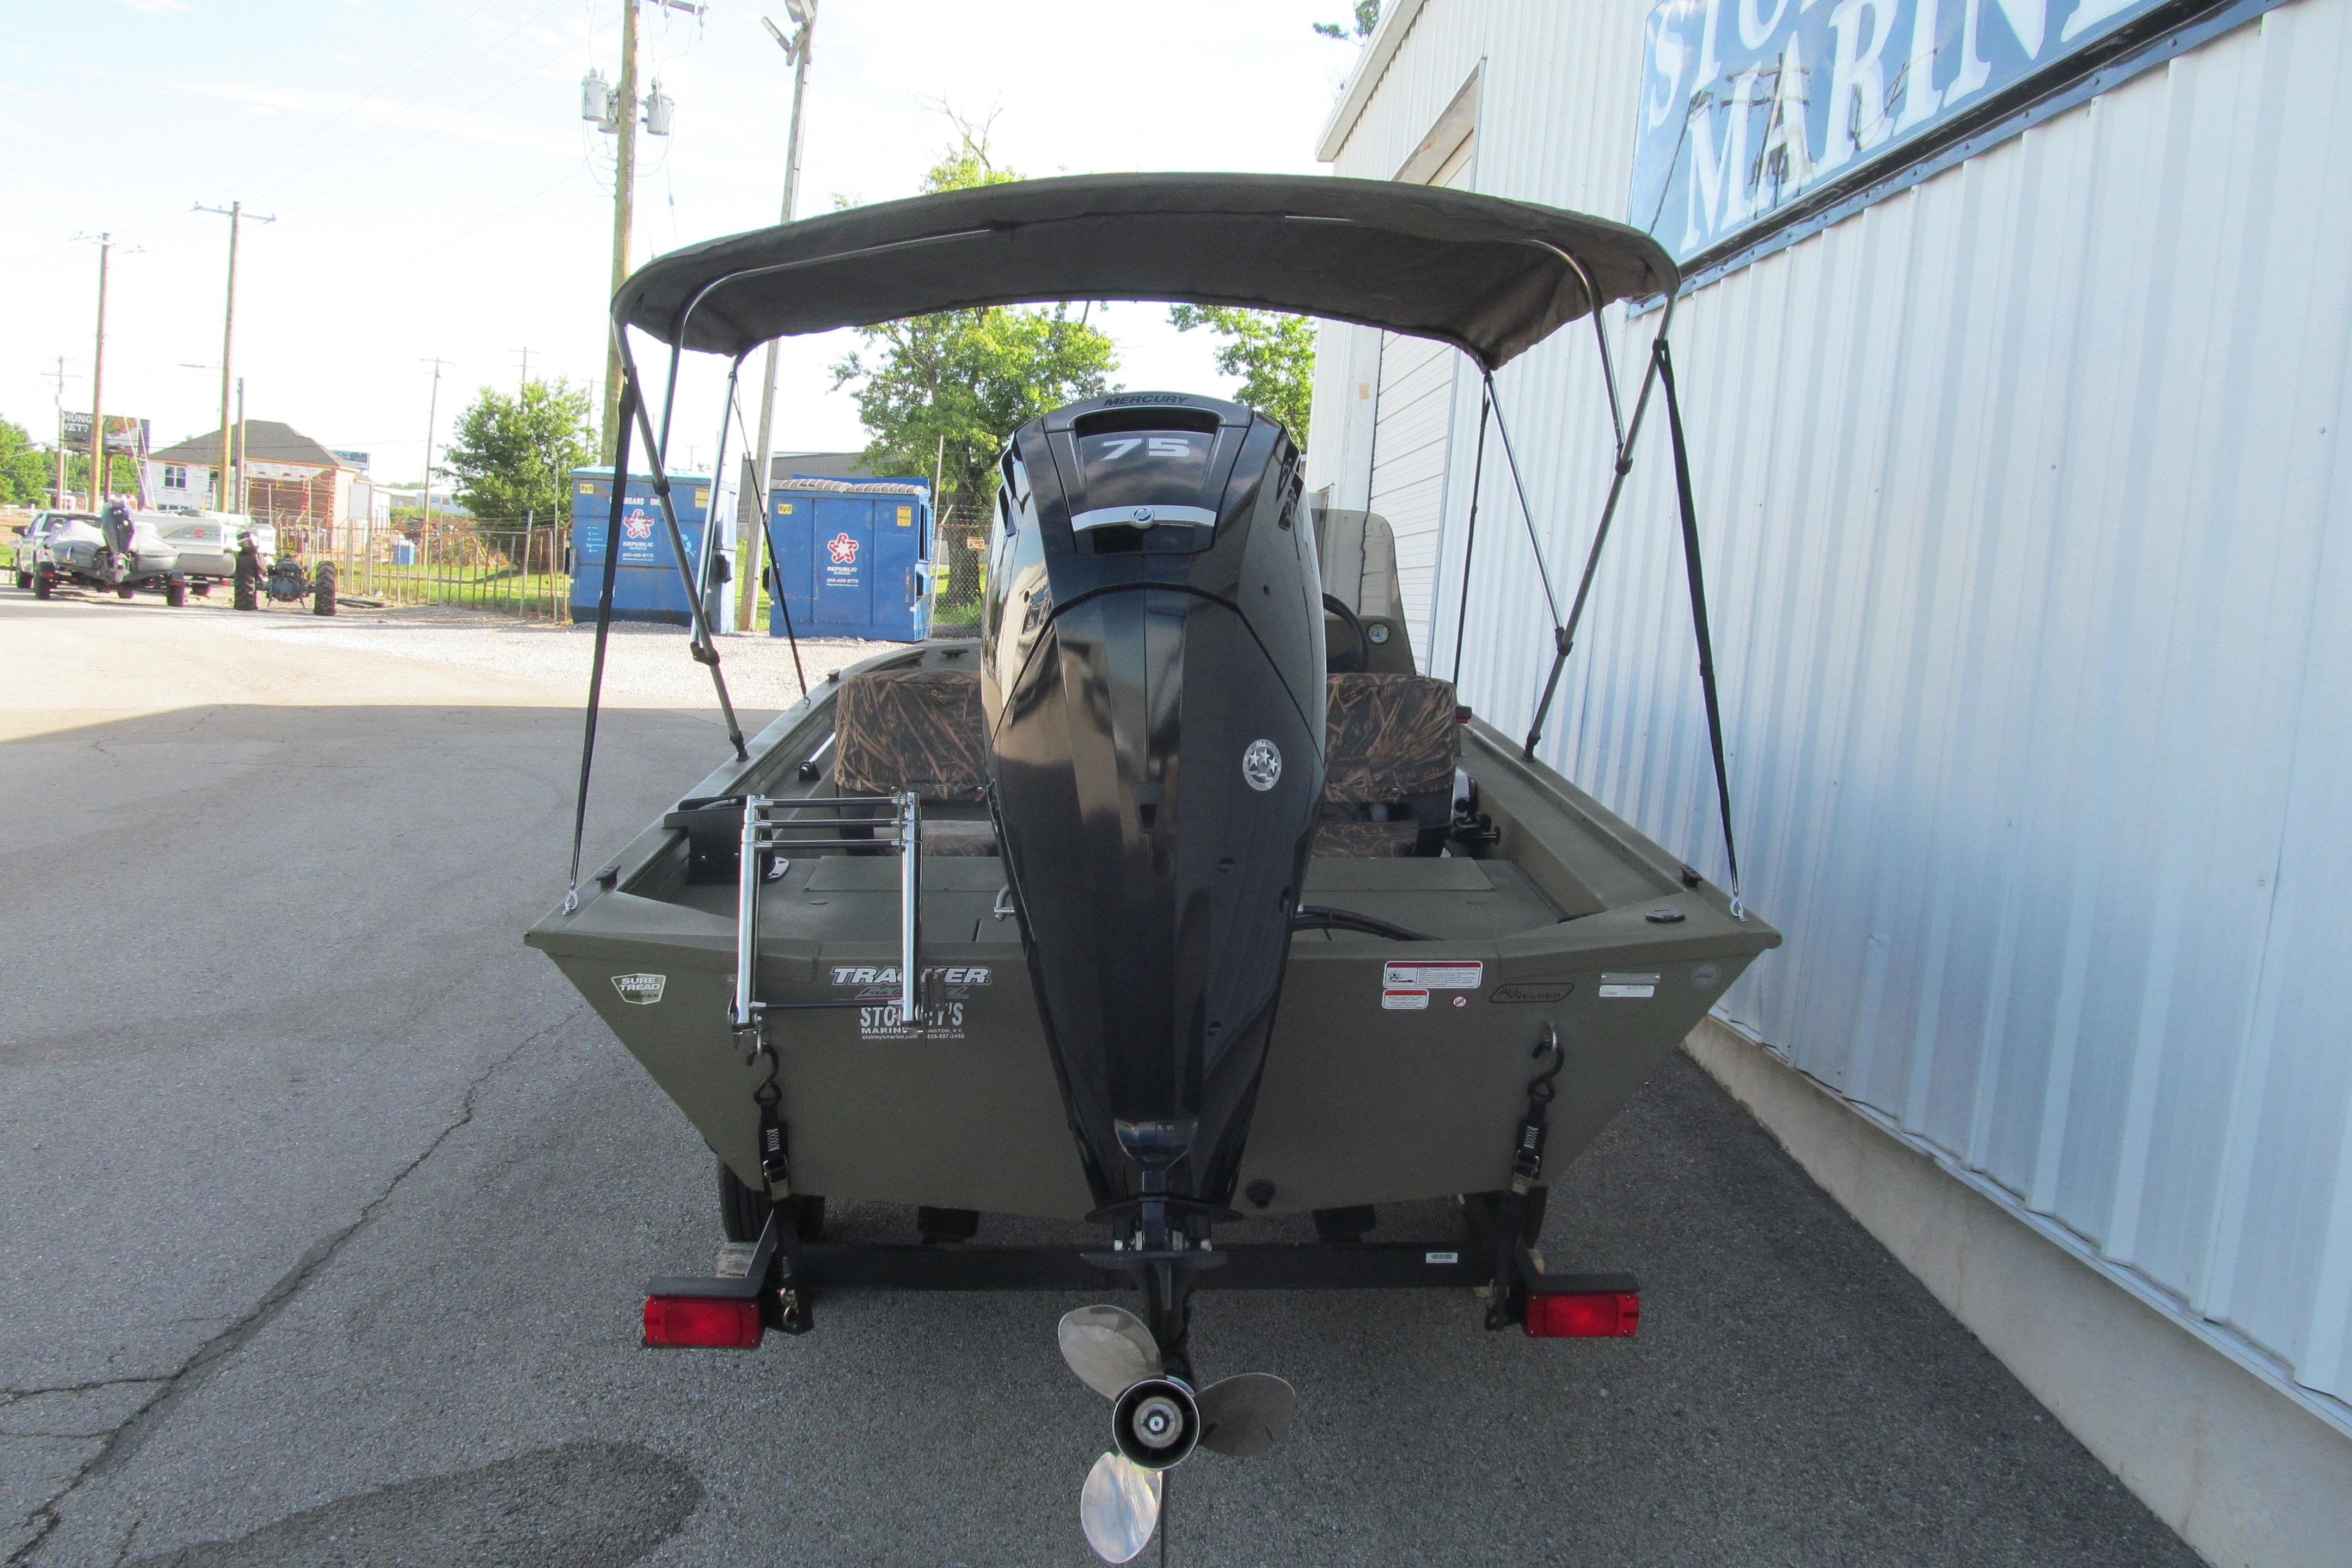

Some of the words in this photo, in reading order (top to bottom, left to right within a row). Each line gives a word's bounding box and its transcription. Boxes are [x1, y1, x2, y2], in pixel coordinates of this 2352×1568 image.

[1680, 0, 2139, 254] MARIN
[1104, 395, 1189, 407] MERCURY
[1102, 438, 1190, 461] 75
[650, 498, 662, 506] ONL
